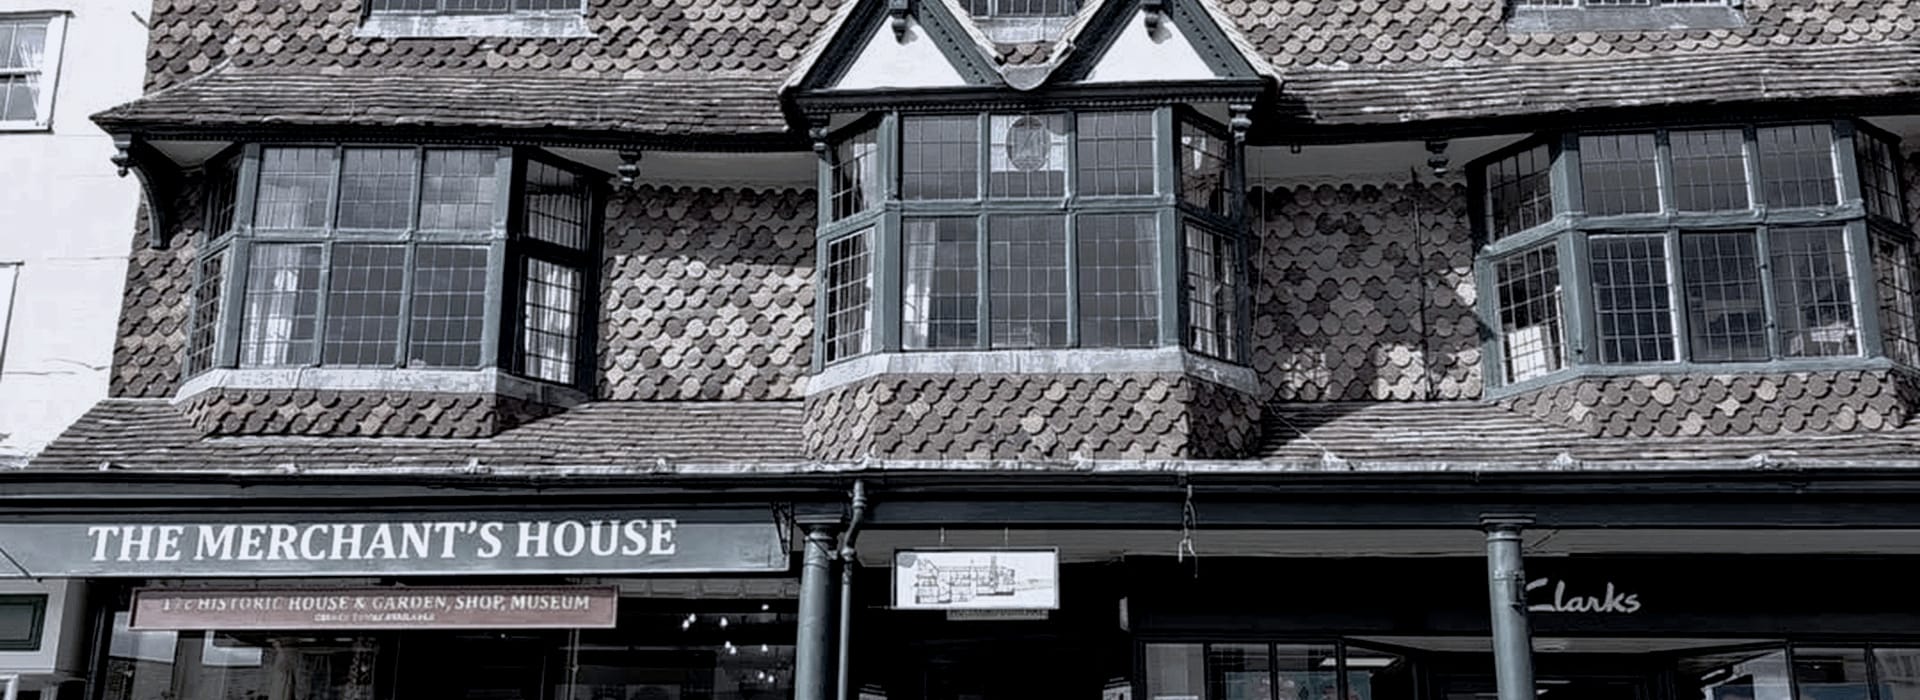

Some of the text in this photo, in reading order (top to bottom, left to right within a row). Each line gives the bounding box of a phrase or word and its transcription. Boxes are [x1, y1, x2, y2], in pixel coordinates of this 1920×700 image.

[88, 519, 677, 561] THE MERCHANT'S HOUSE
[197, 597, 282, 611] HISTORIC
[288, 596, 350, 611] HOUSE
[372, 596, 450, 612] GARDEN,
[455, 595, 506, 611] SHOP,
[510, 595, 590, 611] MUSEUM
[1525, 577, 1641, 614] Clarks
